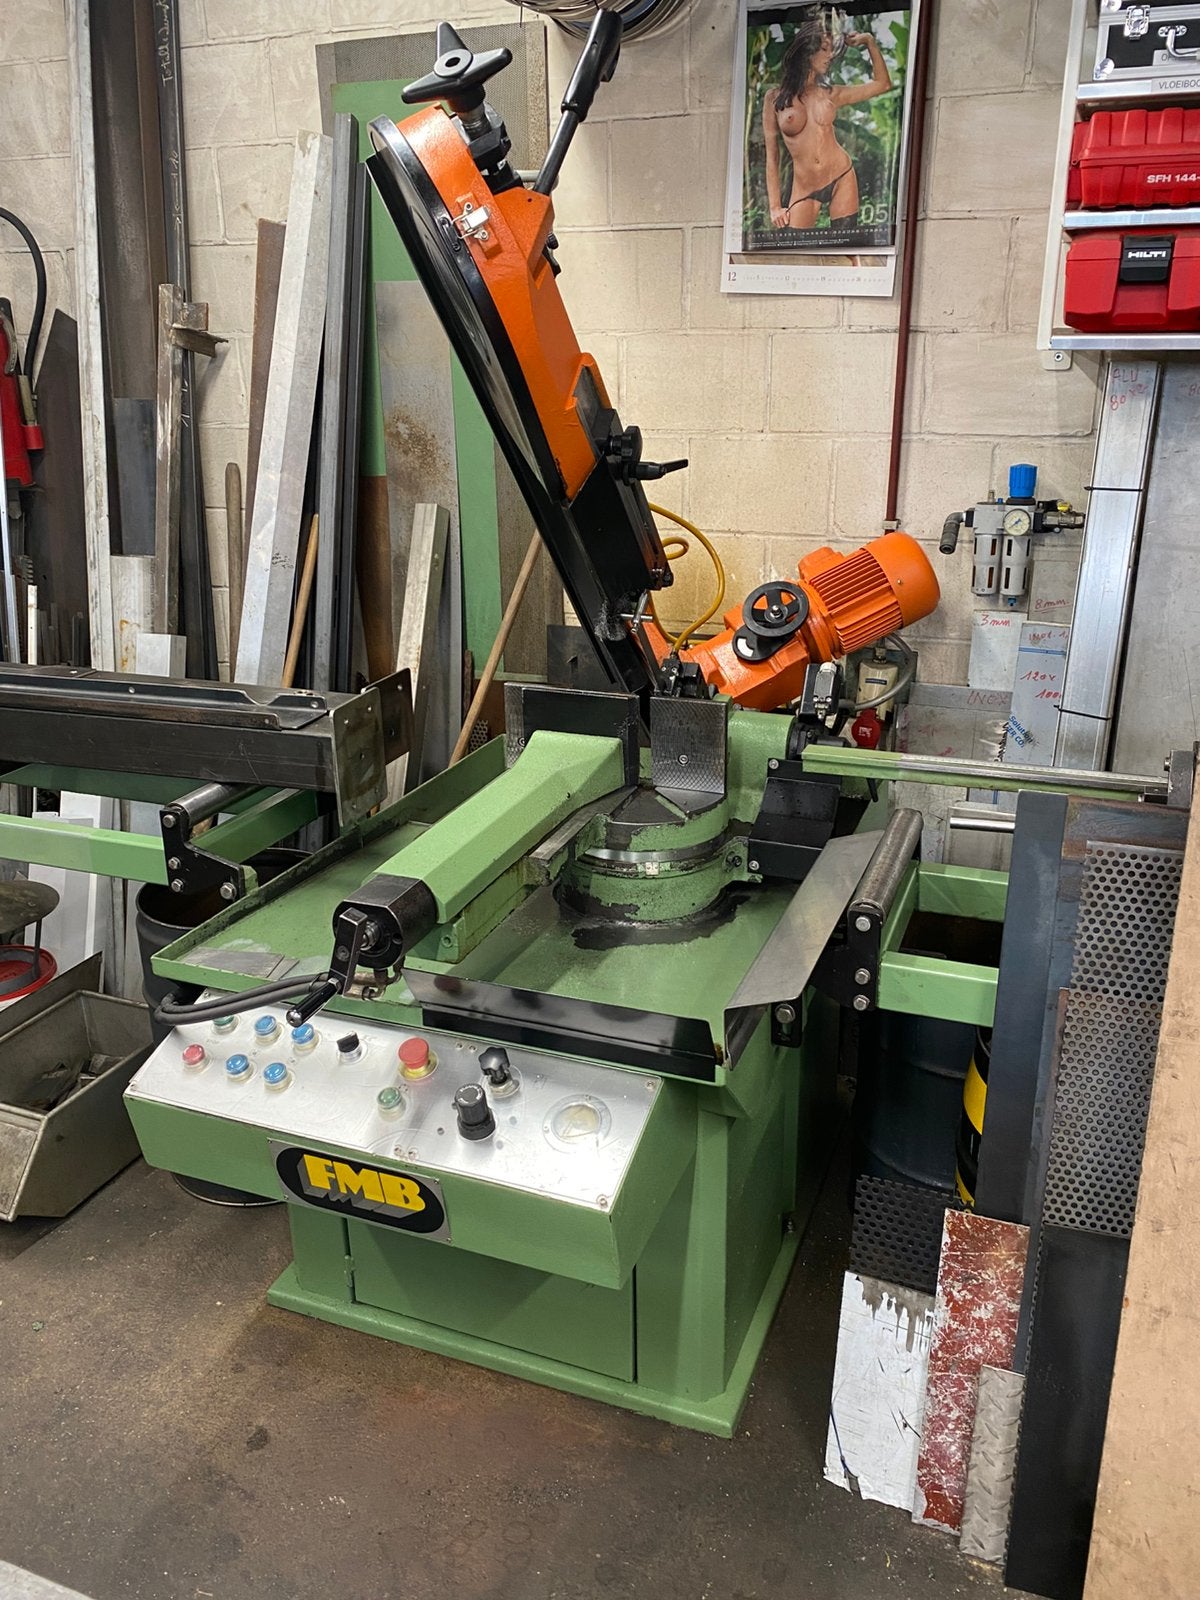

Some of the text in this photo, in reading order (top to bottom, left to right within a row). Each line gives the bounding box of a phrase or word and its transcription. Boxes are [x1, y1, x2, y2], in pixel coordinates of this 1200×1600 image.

[1147, 174, 1172, 184] SFH
[861, 203, 889, 224] 05
[1127, 250, 1166, 259] HILTI
[727, 271, 738, 282] 12
[302, 1153, 426, 1213] FMB
